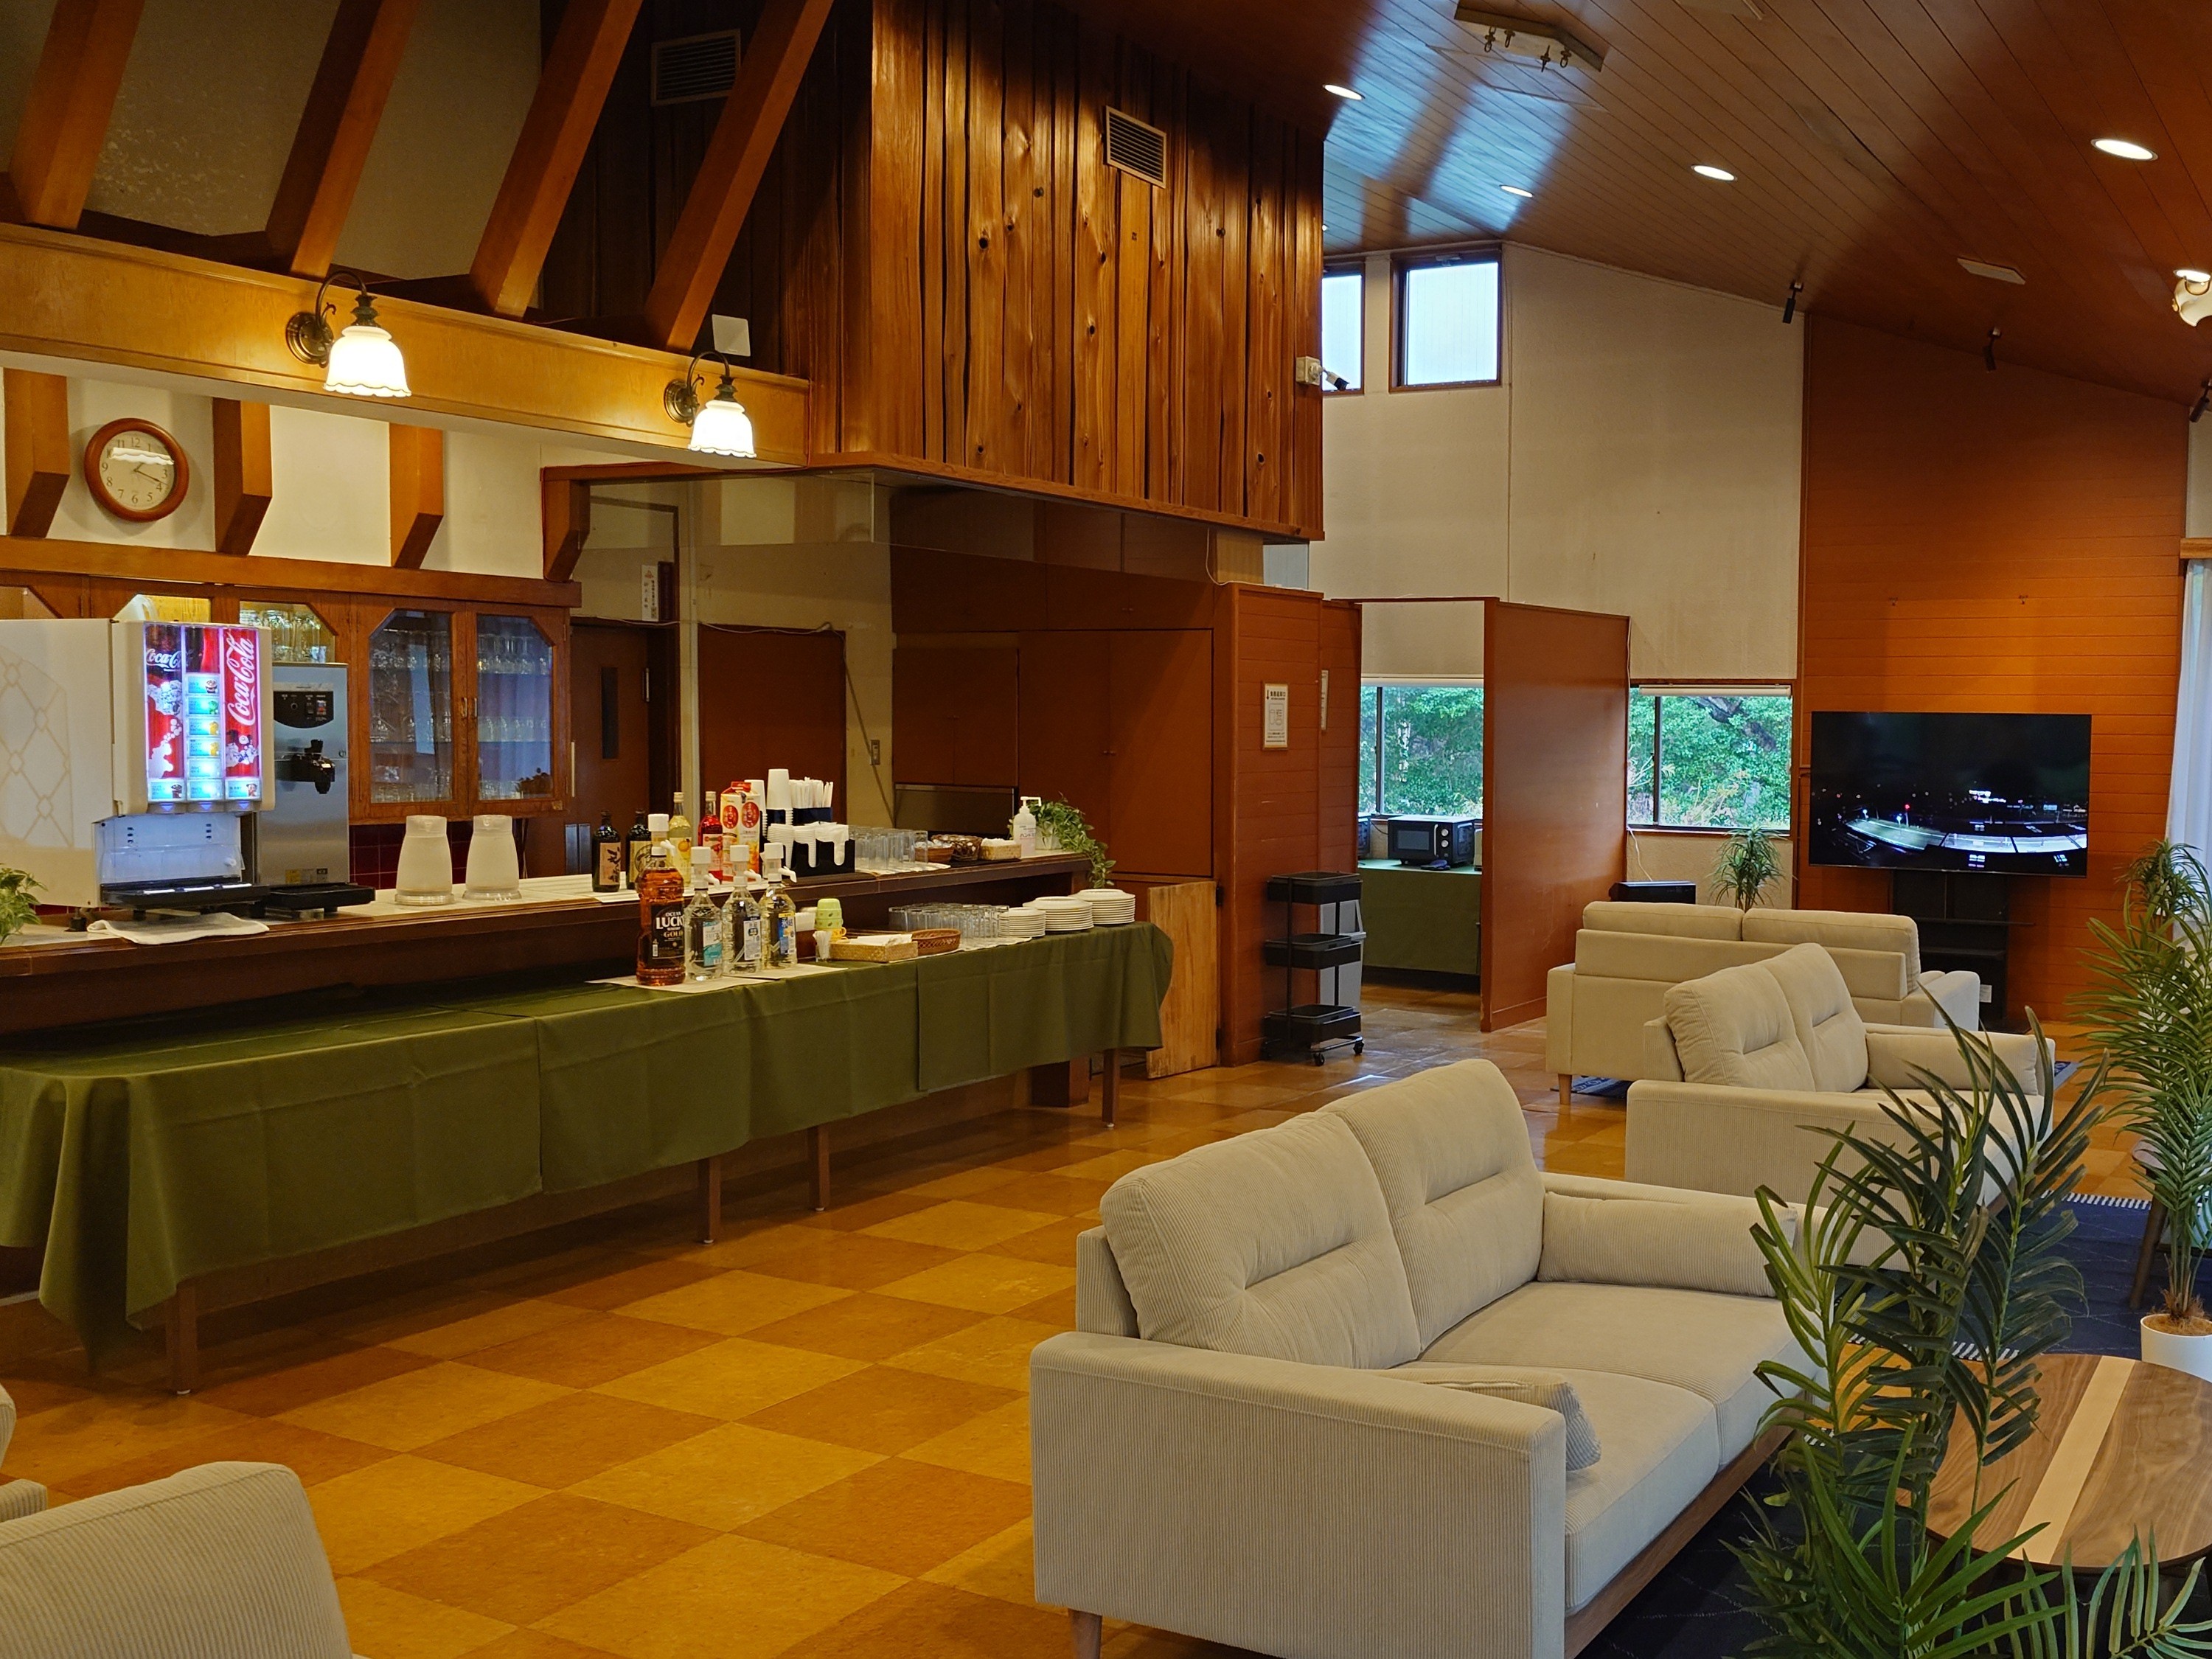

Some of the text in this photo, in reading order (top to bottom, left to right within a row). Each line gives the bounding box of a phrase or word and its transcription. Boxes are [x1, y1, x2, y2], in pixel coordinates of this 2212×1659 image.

[116, 439, 125, 448] 11
[131, 437, 141, 448] 12
[102, 462, 108, 472] 9
[161, 469, 167, 479] 3
[106, 476, 113, 487] 8
[156, 481, 162, 493] 4
[117, 488, 124, 498] 7
[147, 492, 153, 502] 5
[131, 494, 139, 504] 6
[226, 632, 256, 726] Coca-Cola
[655, 915, 684, 930] LUCK
